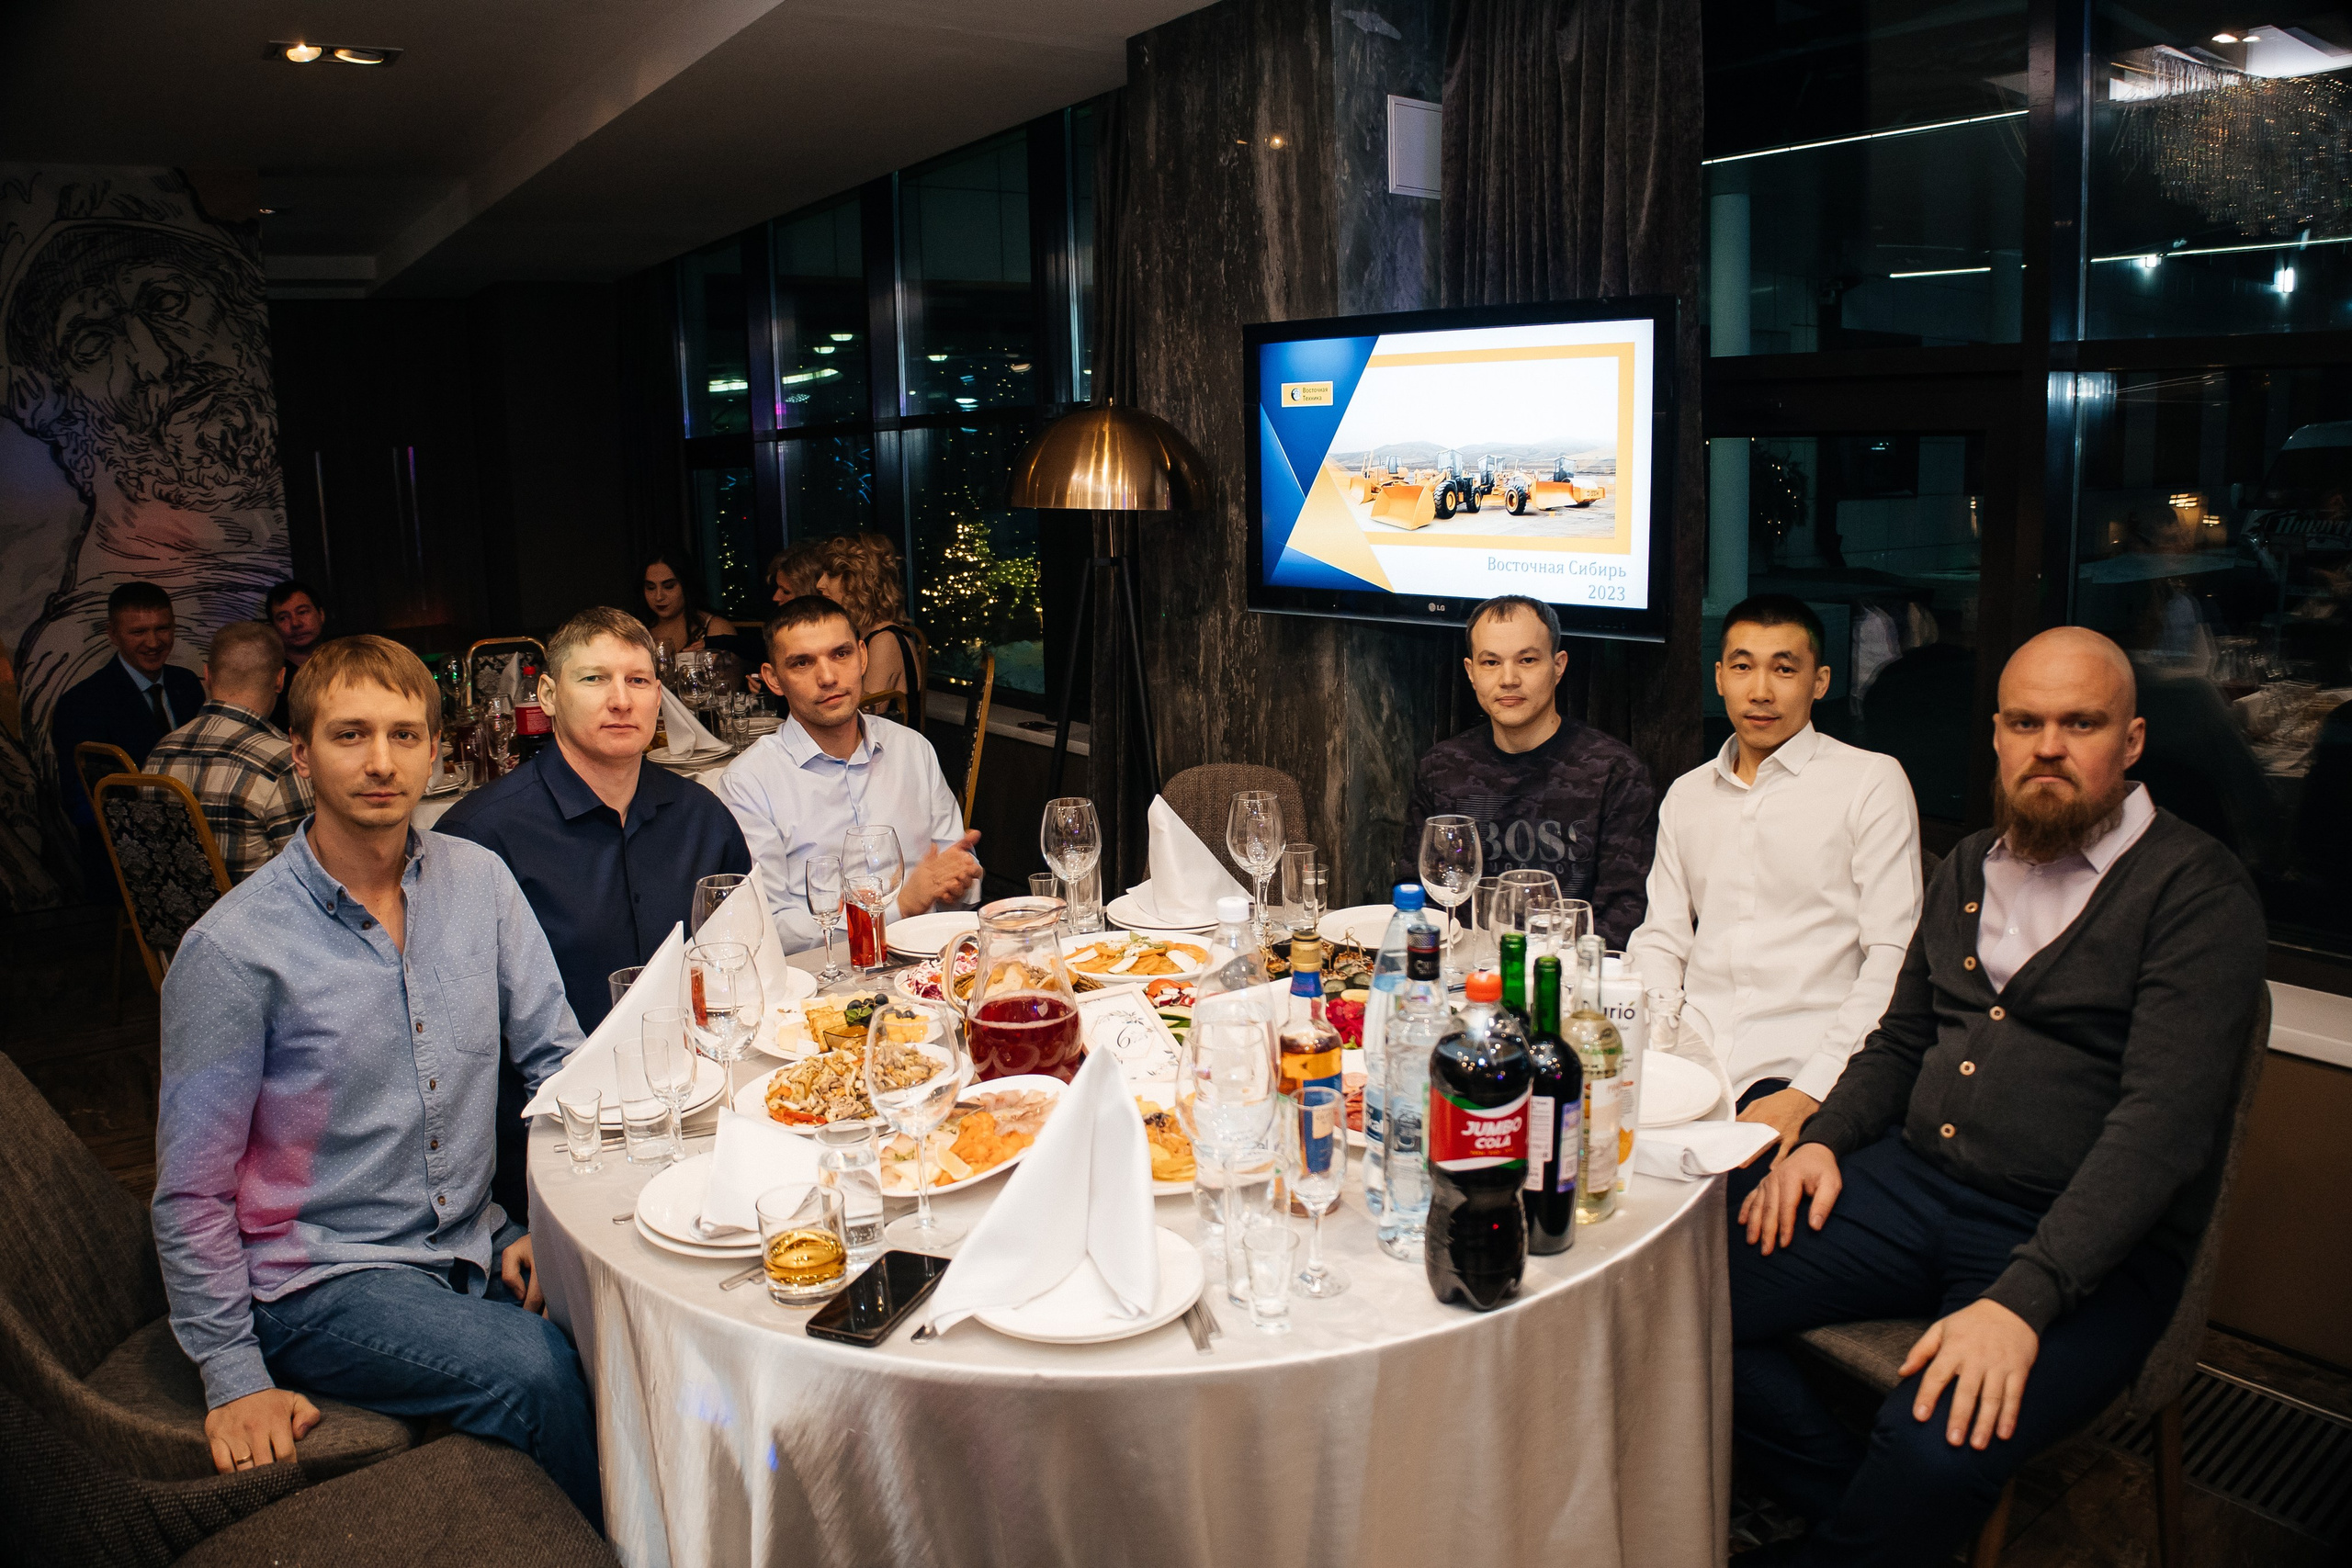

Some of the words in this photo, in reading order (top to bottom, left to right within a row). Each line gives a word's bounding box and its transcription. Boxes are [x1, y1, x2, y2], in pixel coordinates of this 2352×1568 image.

[1487, 556, 1564, 574] Восточная
[1568, 560, 1626, 581] Сибирь
[1588, 584, 1625, 601] 2023
[1483, 819, 1594, 863] BOSS
[1116, 1025, 1131, 1049] 6
[1461, 1116, 1522, 1136] JUMBO
[1474, 1135, 1511, 1149] COLA
